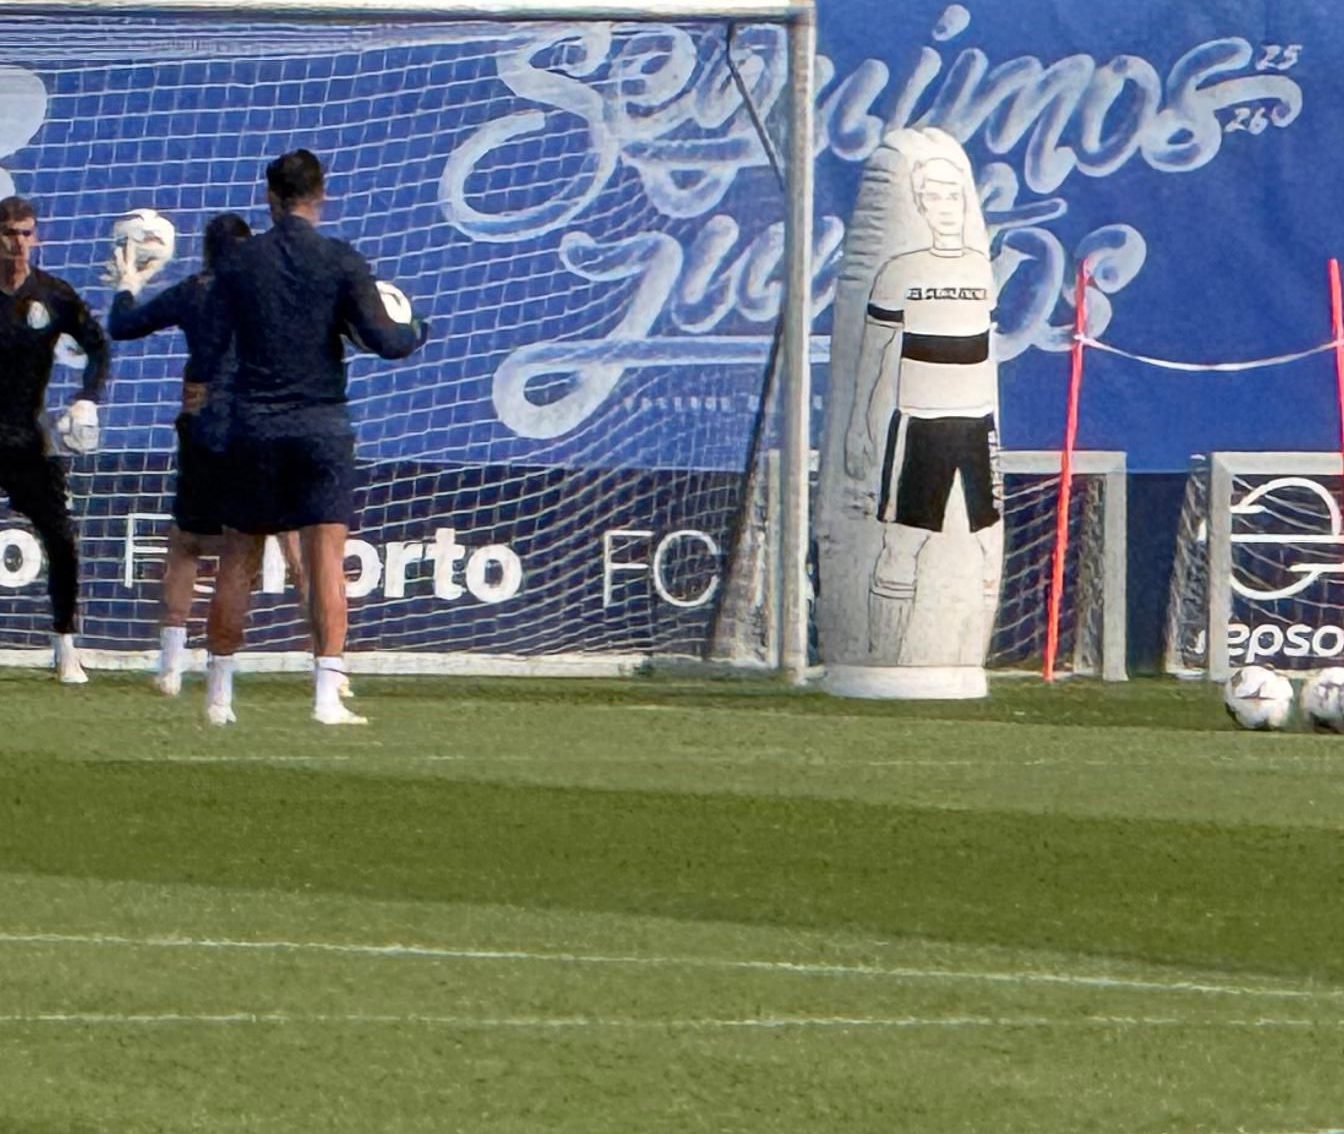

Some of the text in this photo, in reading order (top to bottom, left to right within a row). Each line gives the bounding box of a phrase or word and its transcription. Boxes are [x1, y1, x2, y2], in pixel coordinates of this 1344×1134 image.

[1255, 44, 1304, 72] 25
[1223, 106, 1269, 136] 26
[603, 528, 722, 608] FC
